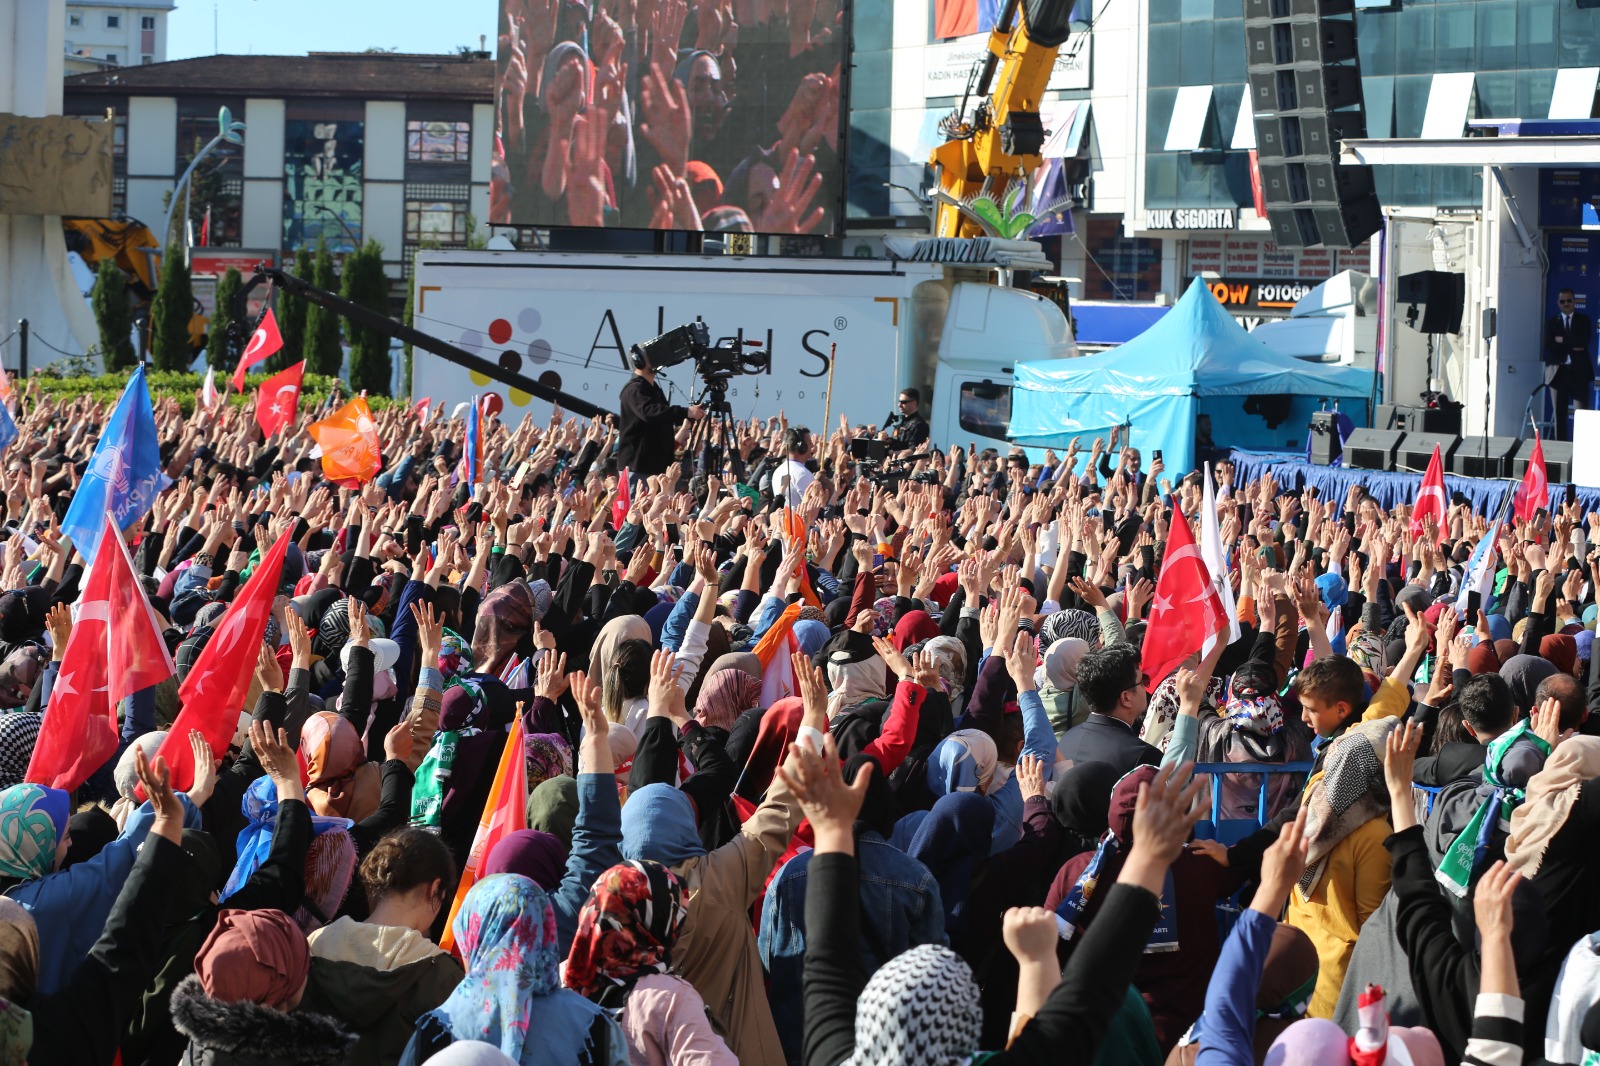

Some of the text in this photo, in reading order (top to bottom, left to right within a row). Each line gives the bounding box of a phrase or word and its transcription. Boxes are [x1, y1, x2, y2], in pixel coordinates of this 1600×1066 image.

[928, 70, 951, 81] KADIN
[1147, 208, 1173, 229] KUK
[1258, 281, 1316, 302] FOTOĞR
[1067, 900, 1077, 909] AK
